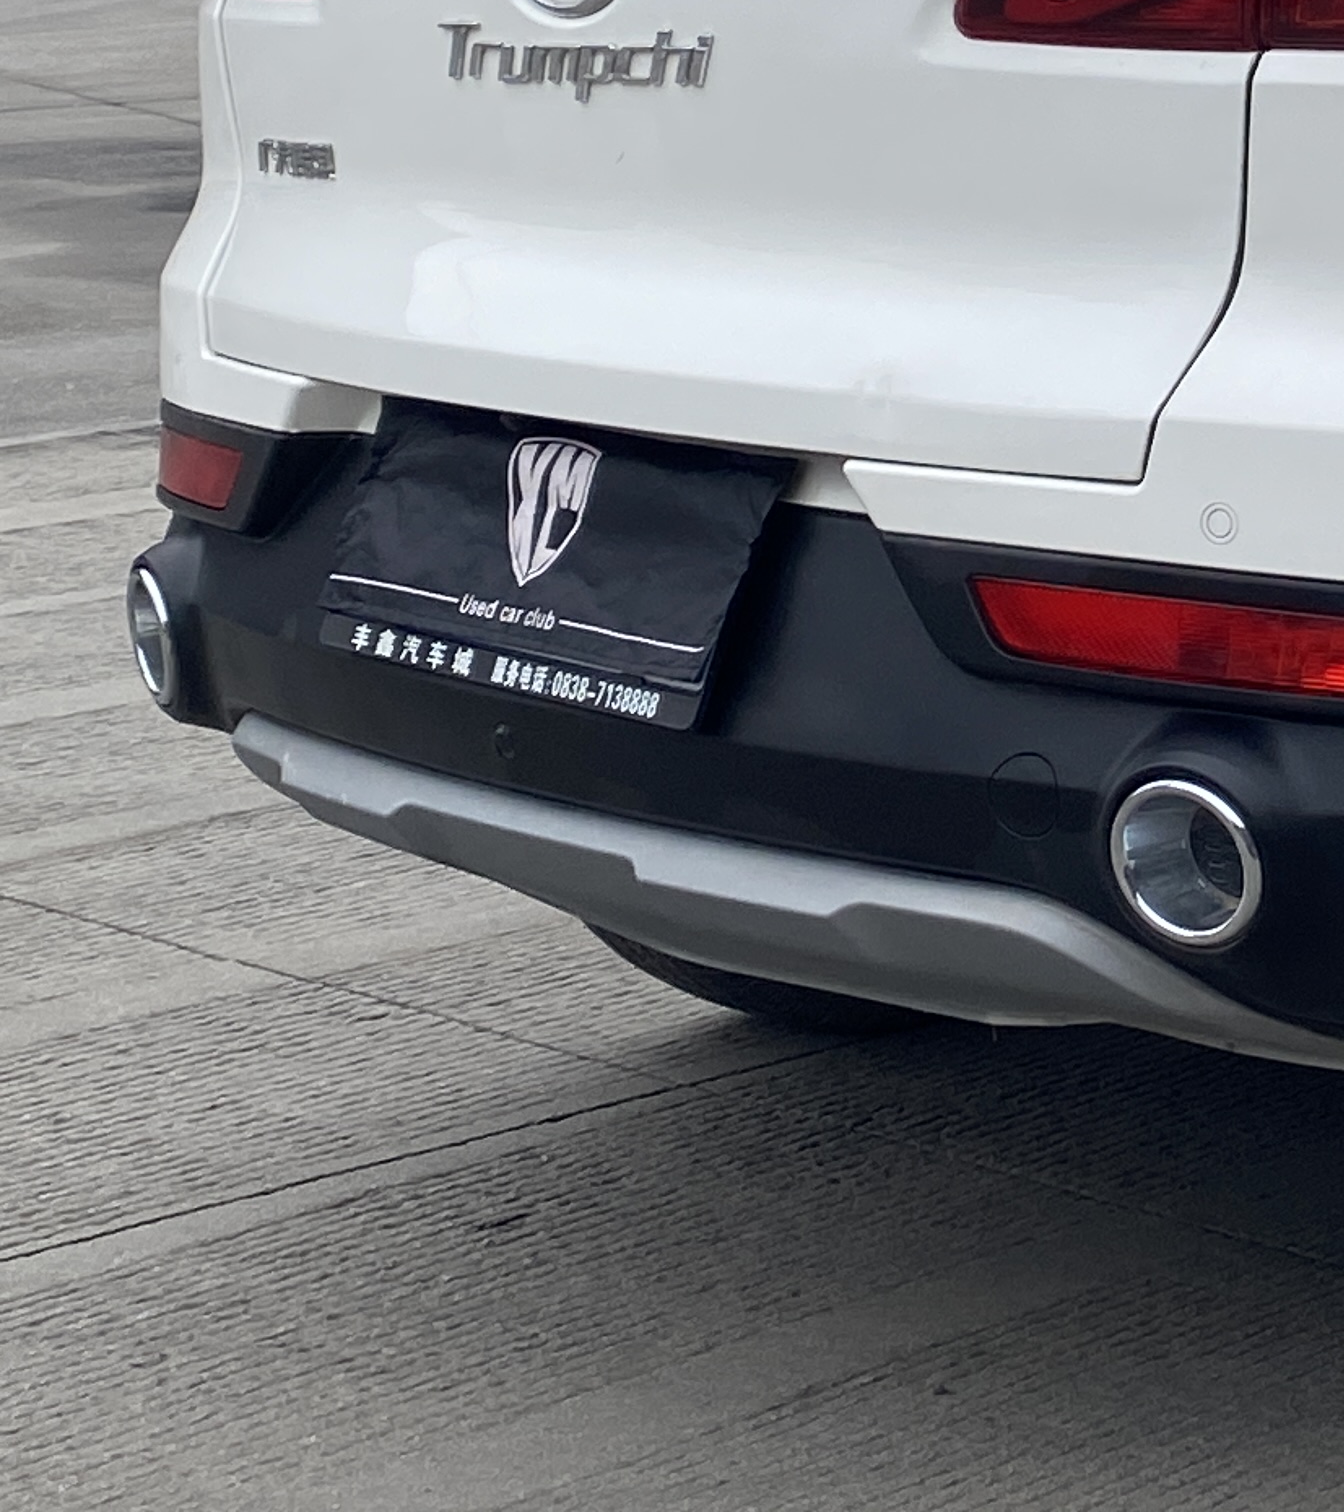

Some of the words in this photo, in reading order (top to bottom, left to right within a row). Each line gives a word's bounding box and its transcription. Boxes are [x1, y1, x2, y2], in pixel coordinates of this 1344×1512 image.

[437, 22, 714, 104] Trumpchi
[459, 593, 500, 619] Used
[499, 605, 525, 624] car
[523, 607, 556, 630] club
